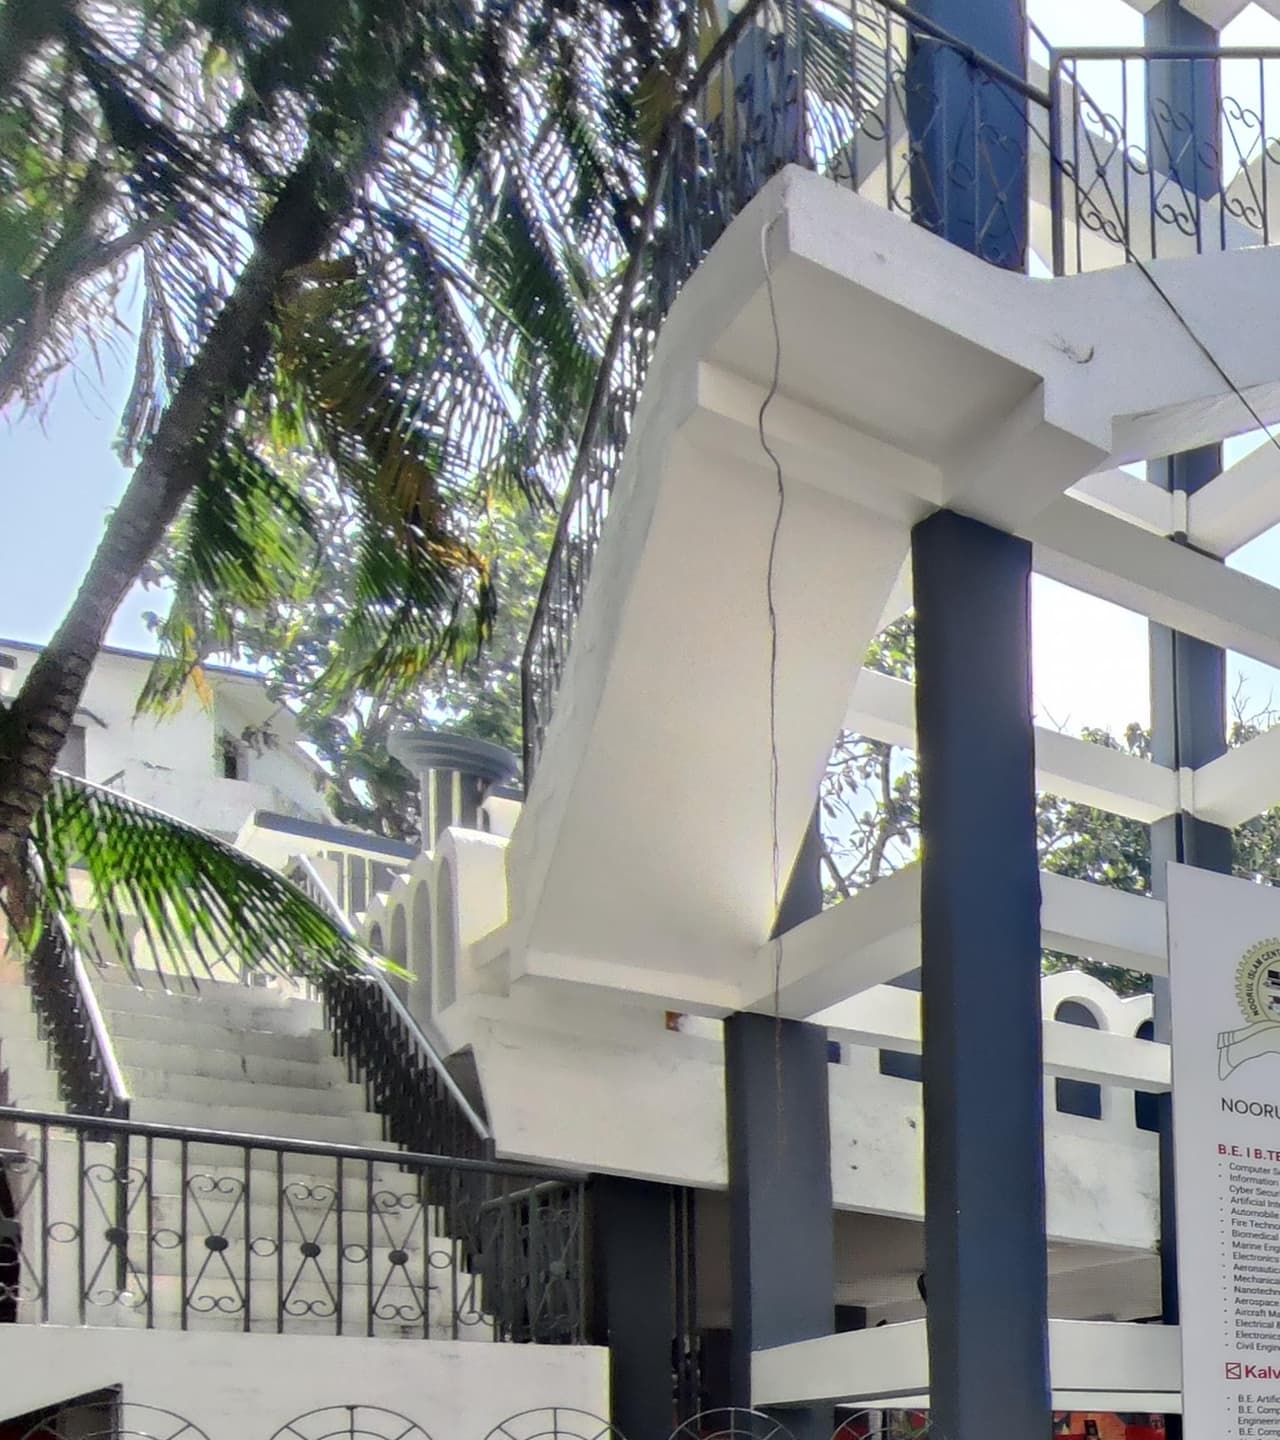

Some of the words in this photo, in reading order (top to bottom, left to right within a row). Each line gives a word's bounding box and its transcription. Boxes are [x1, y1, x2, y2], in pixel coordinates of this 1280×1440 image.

[1248, 958, 1263, 983] ISLAM
[1246, 983, 1259, 1016] NOORUL
[1229, 1162, 1271, 1174] Computer
[1230, 1196, 1266, 1207] Artificial
[1230, 1207, 1279, 1219] Automobile
[1231, 1218, 1248, 1227] Fire
[1231, 1229, 1279, 1241] Biomedical
[1232, 1240, 1262, 1250] Marine
[1233, 1251, 1279, 1263] Electronics
[1234, 1297, 1279, 1307] Aerospace
[1235, 1308, 1266, 1317] Aircraft
[1235, 1319, 1274, 1329] Electrical
[1236, 1341, 1255, 1350] Civil
